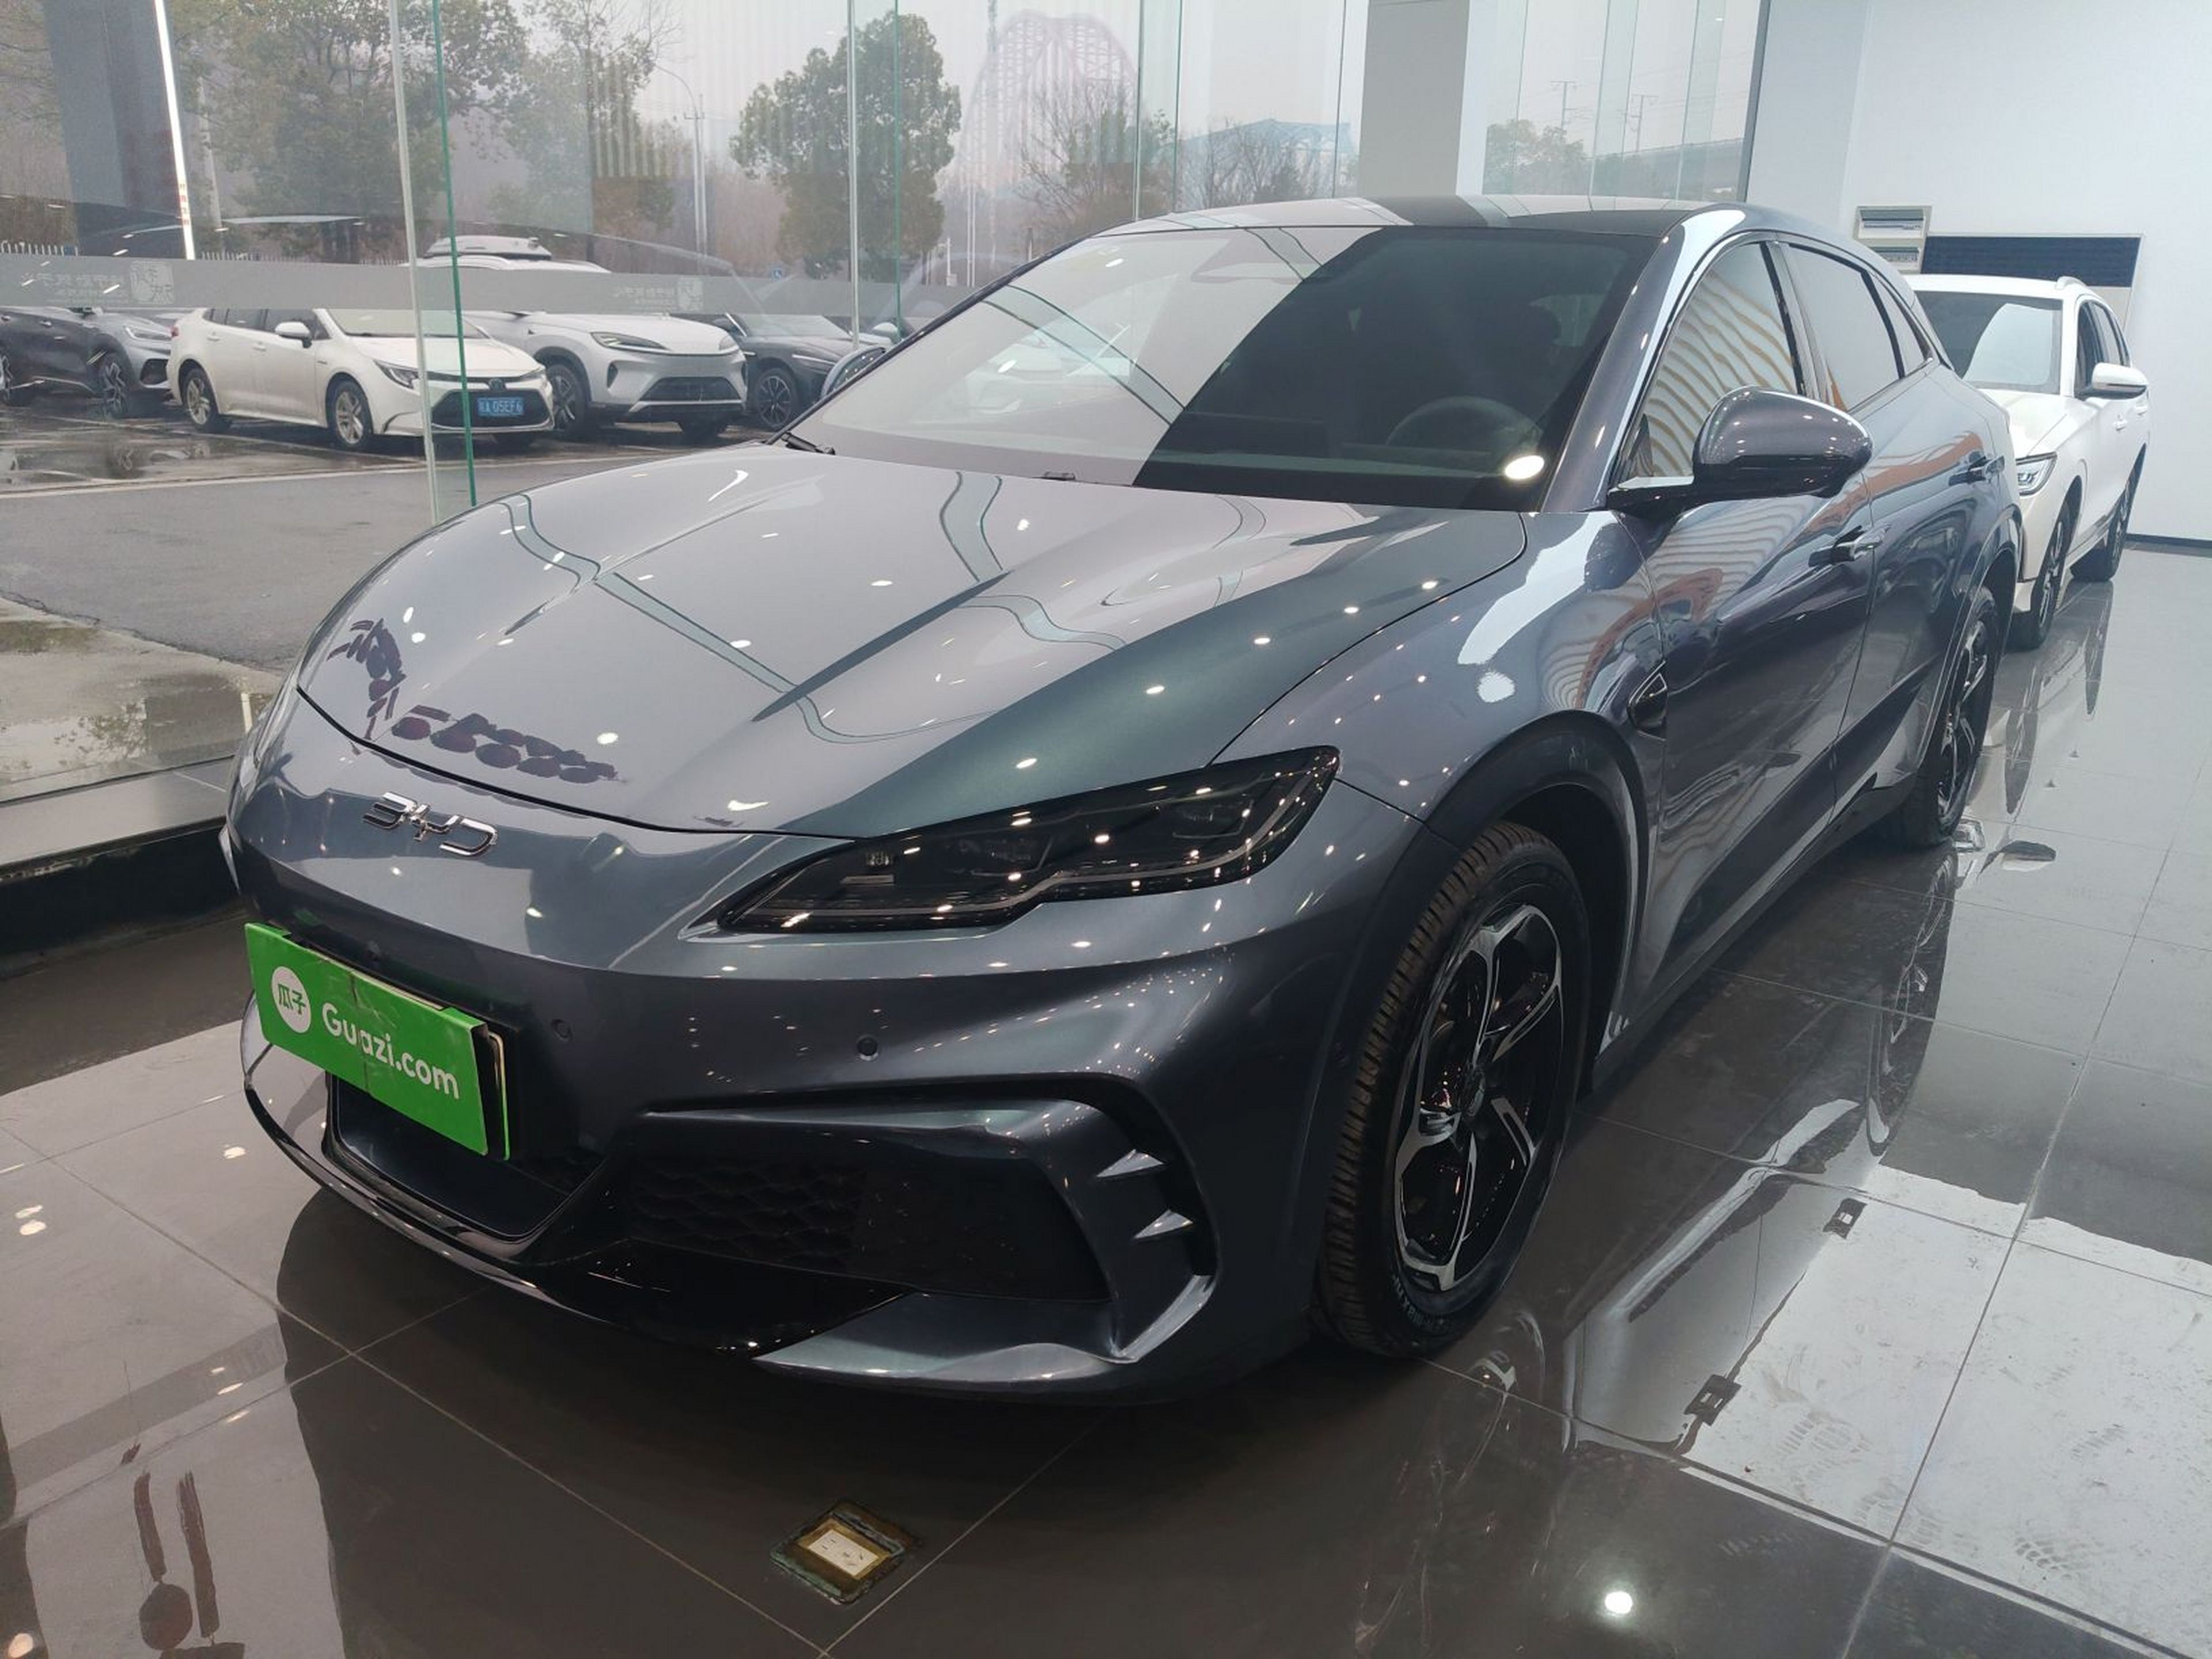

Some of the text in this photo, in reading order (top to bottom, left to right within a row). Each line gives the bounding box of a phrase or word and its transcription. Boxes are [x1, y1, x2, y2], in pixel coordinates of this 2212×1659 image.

[363, 791, 498, 857] BYD
[278, 983, 307, 1016] 瓜子
[321, 1002, 460, 1100] Guazi.com
